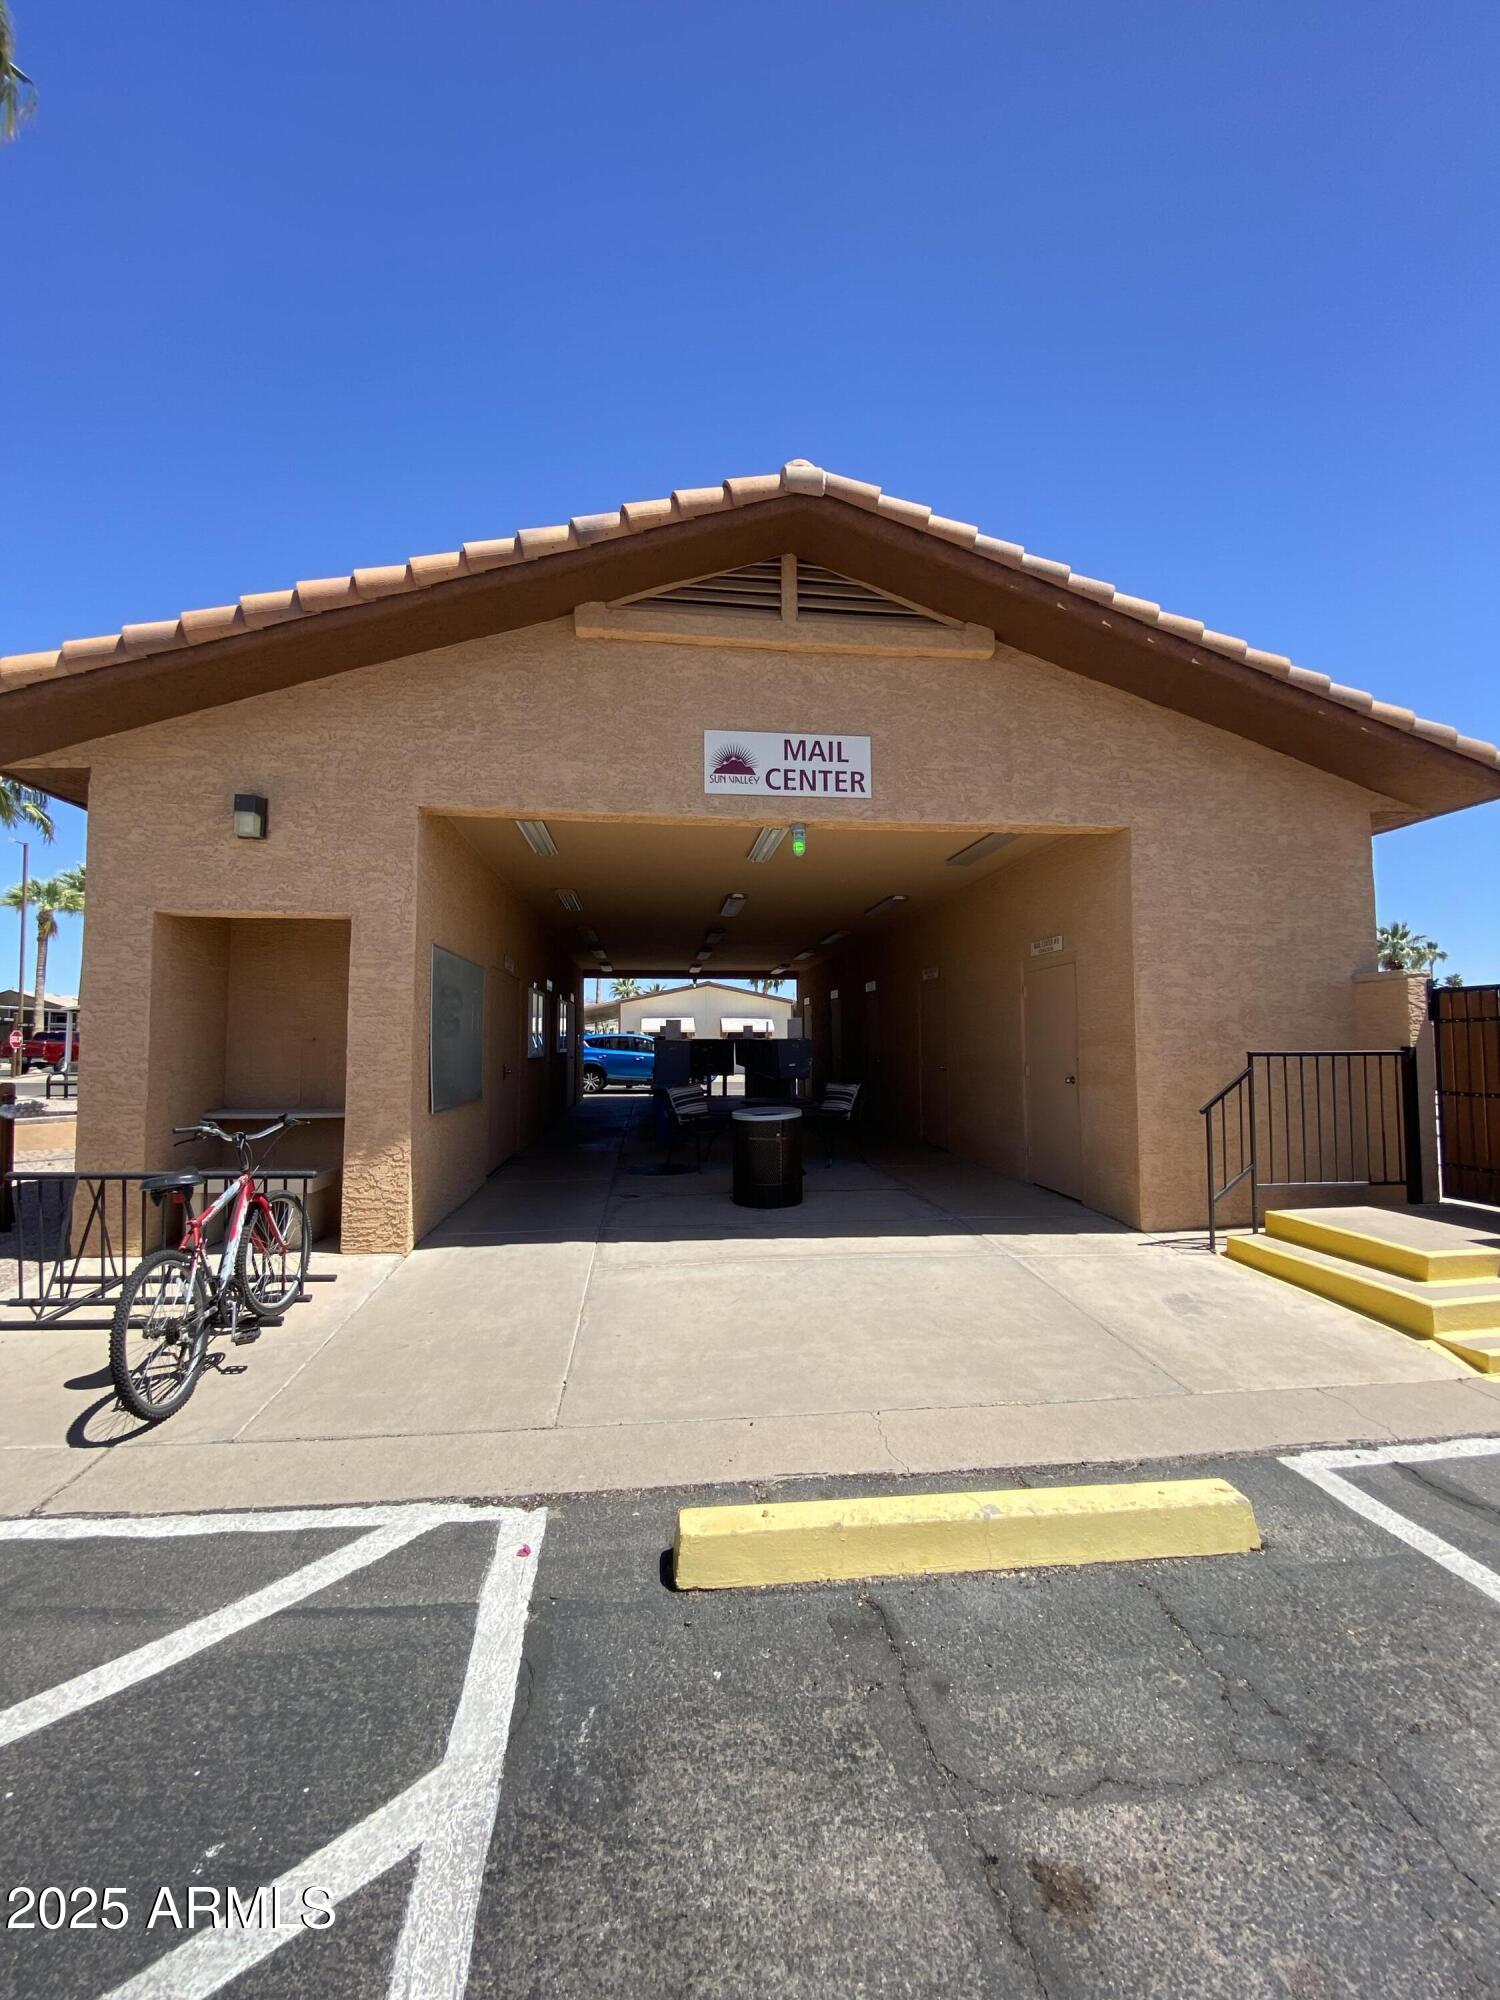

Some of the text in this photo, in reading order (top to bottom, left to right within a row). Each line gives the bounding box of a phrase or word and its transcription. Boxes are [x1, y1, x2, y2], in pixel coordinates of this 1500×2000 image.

[783, 739, 849, 763] MAIL
[709, 774, 760, 784] SUN VALLEY
[765, 768, 866, 793] CENTER
